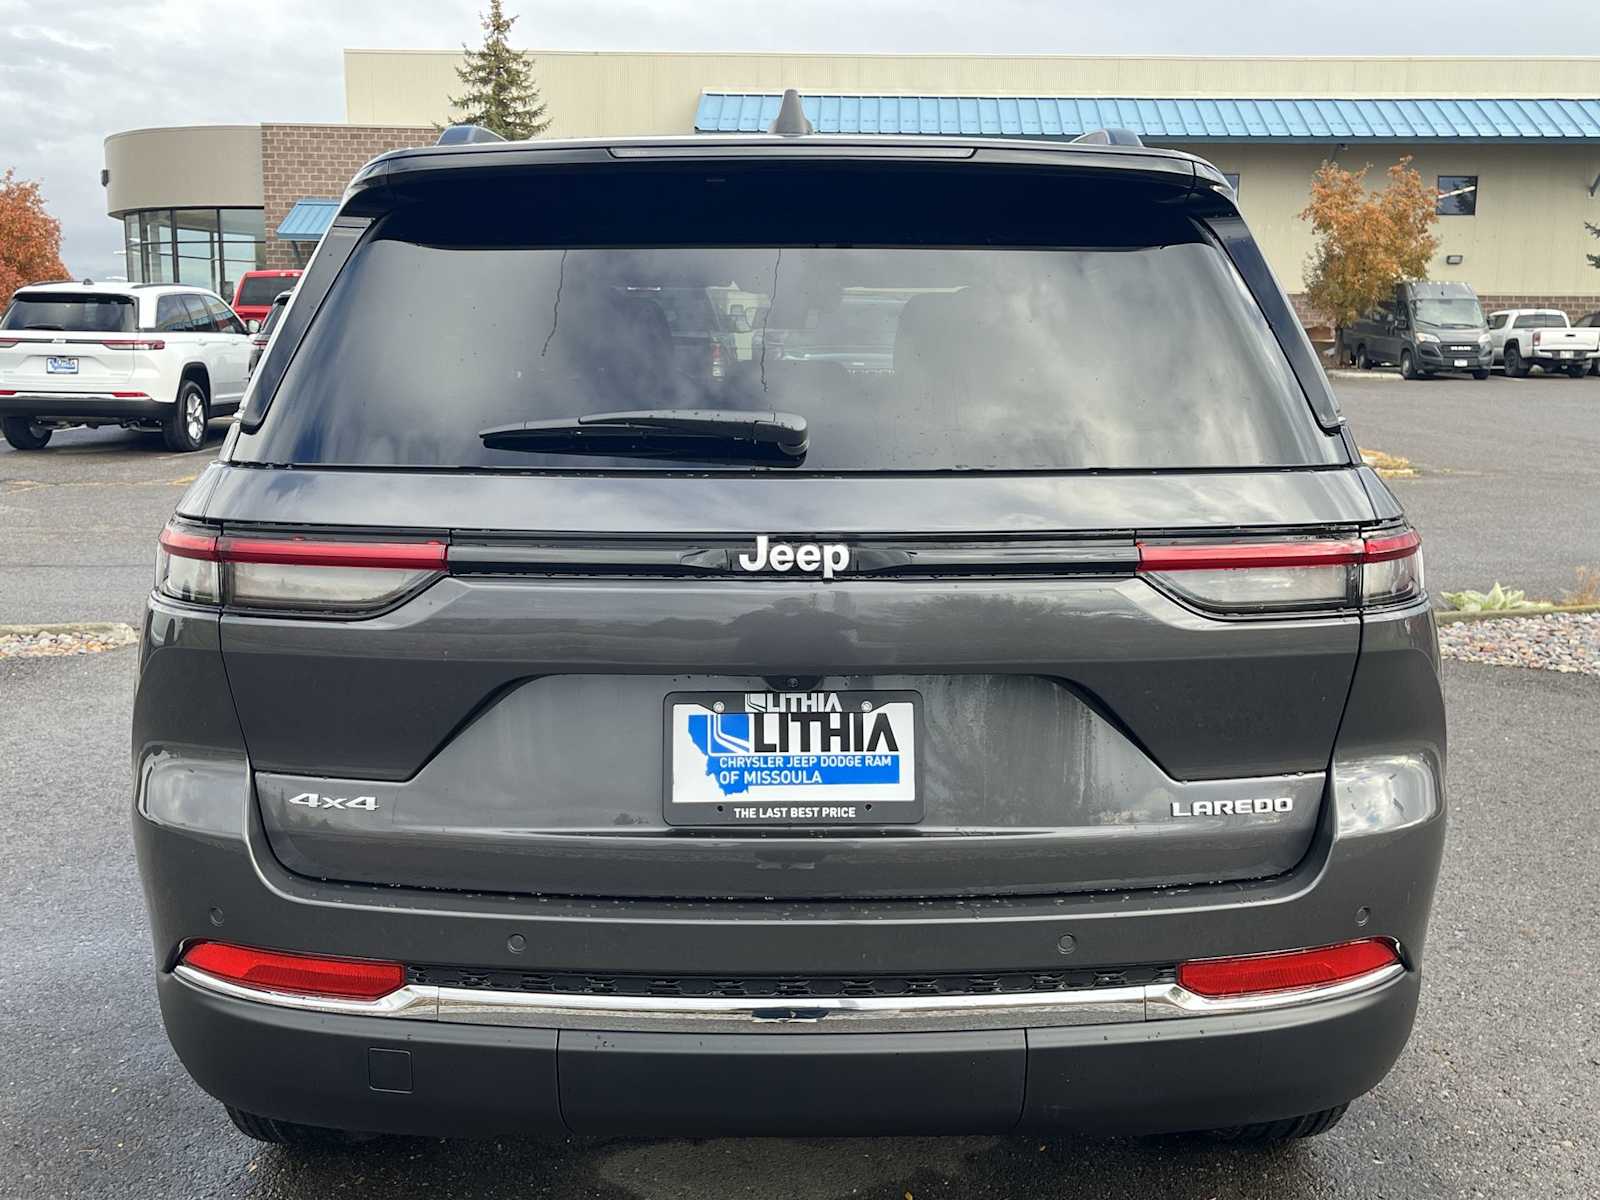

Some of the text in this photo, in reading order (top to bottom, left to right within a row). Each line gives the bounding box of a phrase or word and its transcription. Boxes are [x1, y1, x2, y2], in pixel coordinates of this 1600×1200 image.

[739, 535, 850, 579] Jeep
[767, 693, 842, 712] LITHIA
[754, 713, 899, 752] LITHIA
[719, 756, 892, 768] CHRYSLER JEEP DODGE RAM
[719, 770, 823, 784] OF MISSOULA
[289, 793, 380, 811] 4x4
[1171, 798, 1294, 817] LAREDO
[734, 807, 856, 818] THE LAST BEST PRICE
